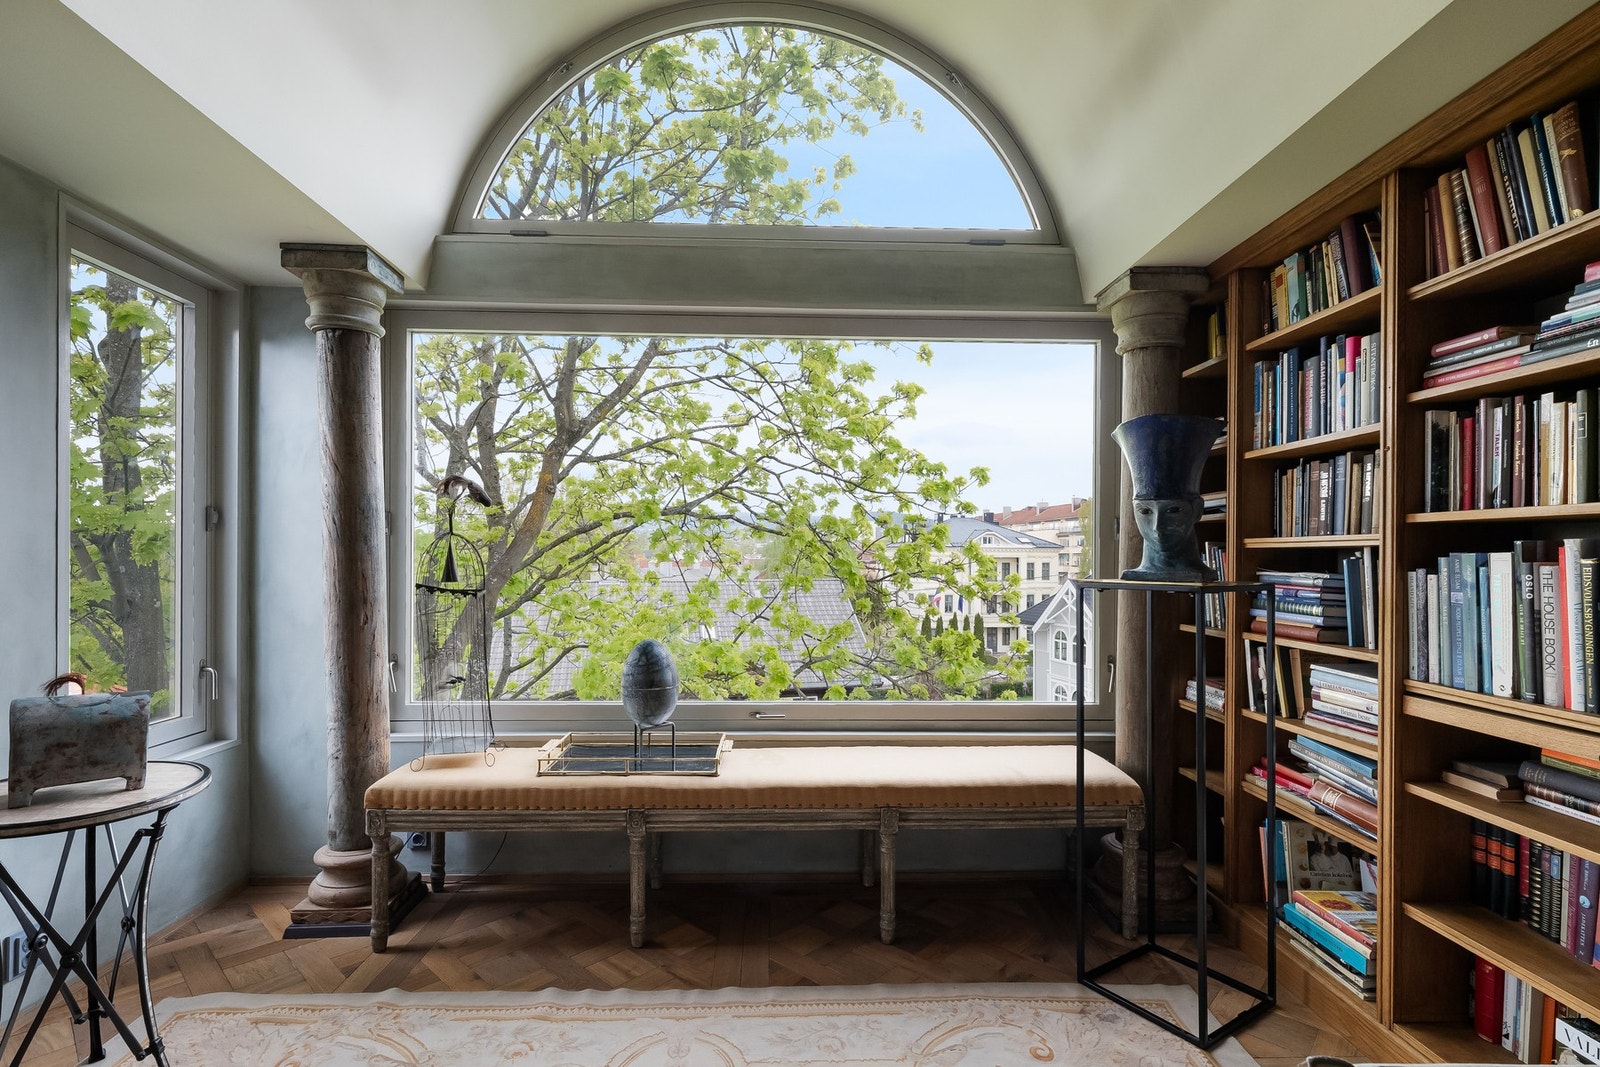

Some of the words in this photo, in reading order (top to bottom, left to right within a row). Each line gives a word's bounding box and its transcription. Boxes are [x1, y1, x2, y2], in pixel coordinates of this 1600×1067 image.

[1525, 574, 1533, 600] OSLO
[1542, 571, 1553, 593] THE
[1543, 596, 1555, 635] HOUSE
[1583, 567, 1594, 664] EIDSVOLLSBYGNINGEN
[1544, 638, 1556, 671] BOOK
